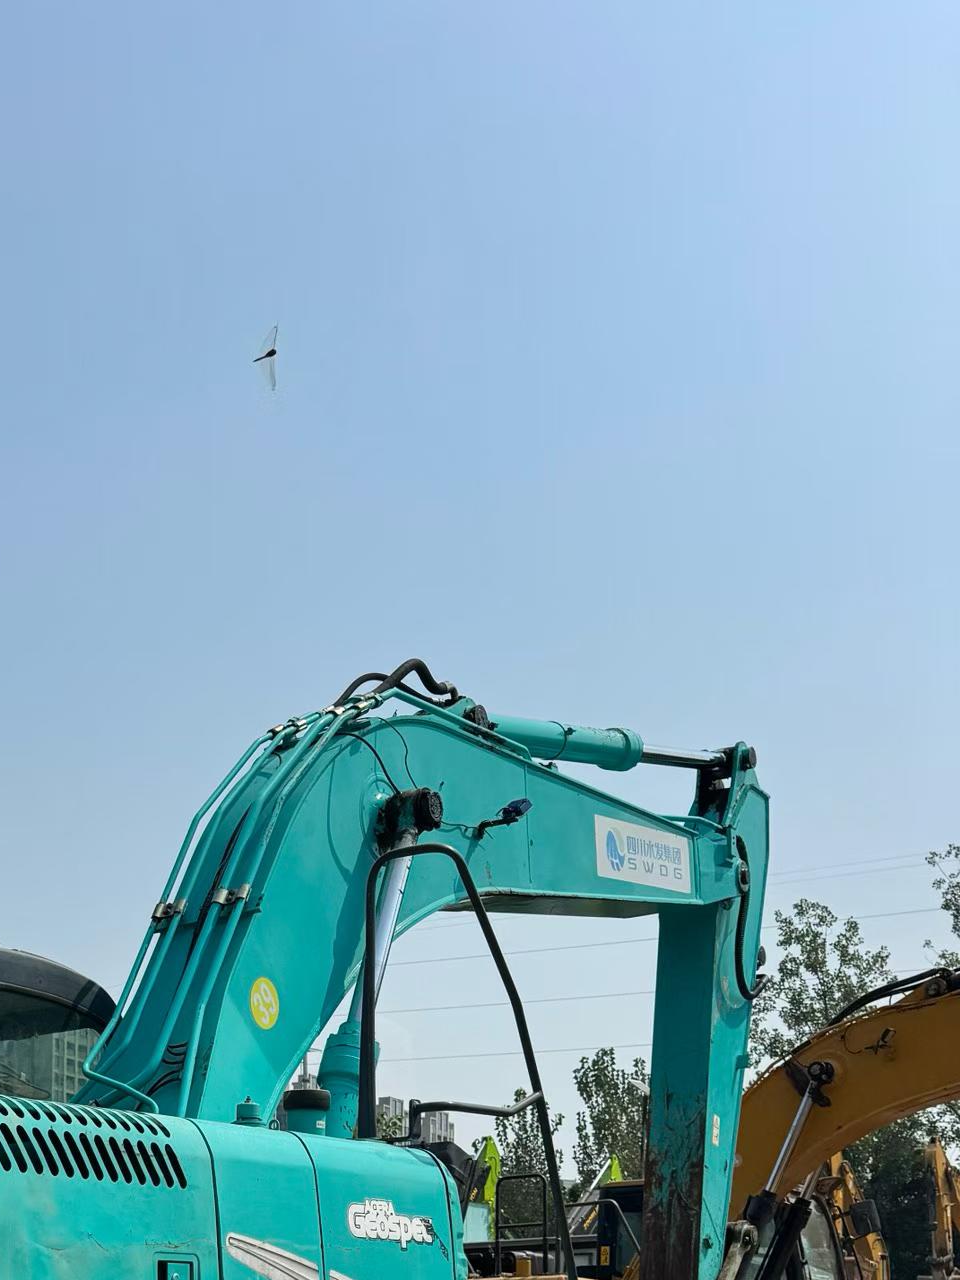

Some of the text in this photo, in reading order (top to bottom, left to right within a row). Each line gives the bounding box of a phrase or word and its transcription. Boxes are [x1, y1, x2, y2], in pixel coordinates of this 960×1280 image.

[626, 835, 681, 866] 四川水发集团
[627, 857, 683, 880] SWDG
[253, 982, 275, 1025] 39
